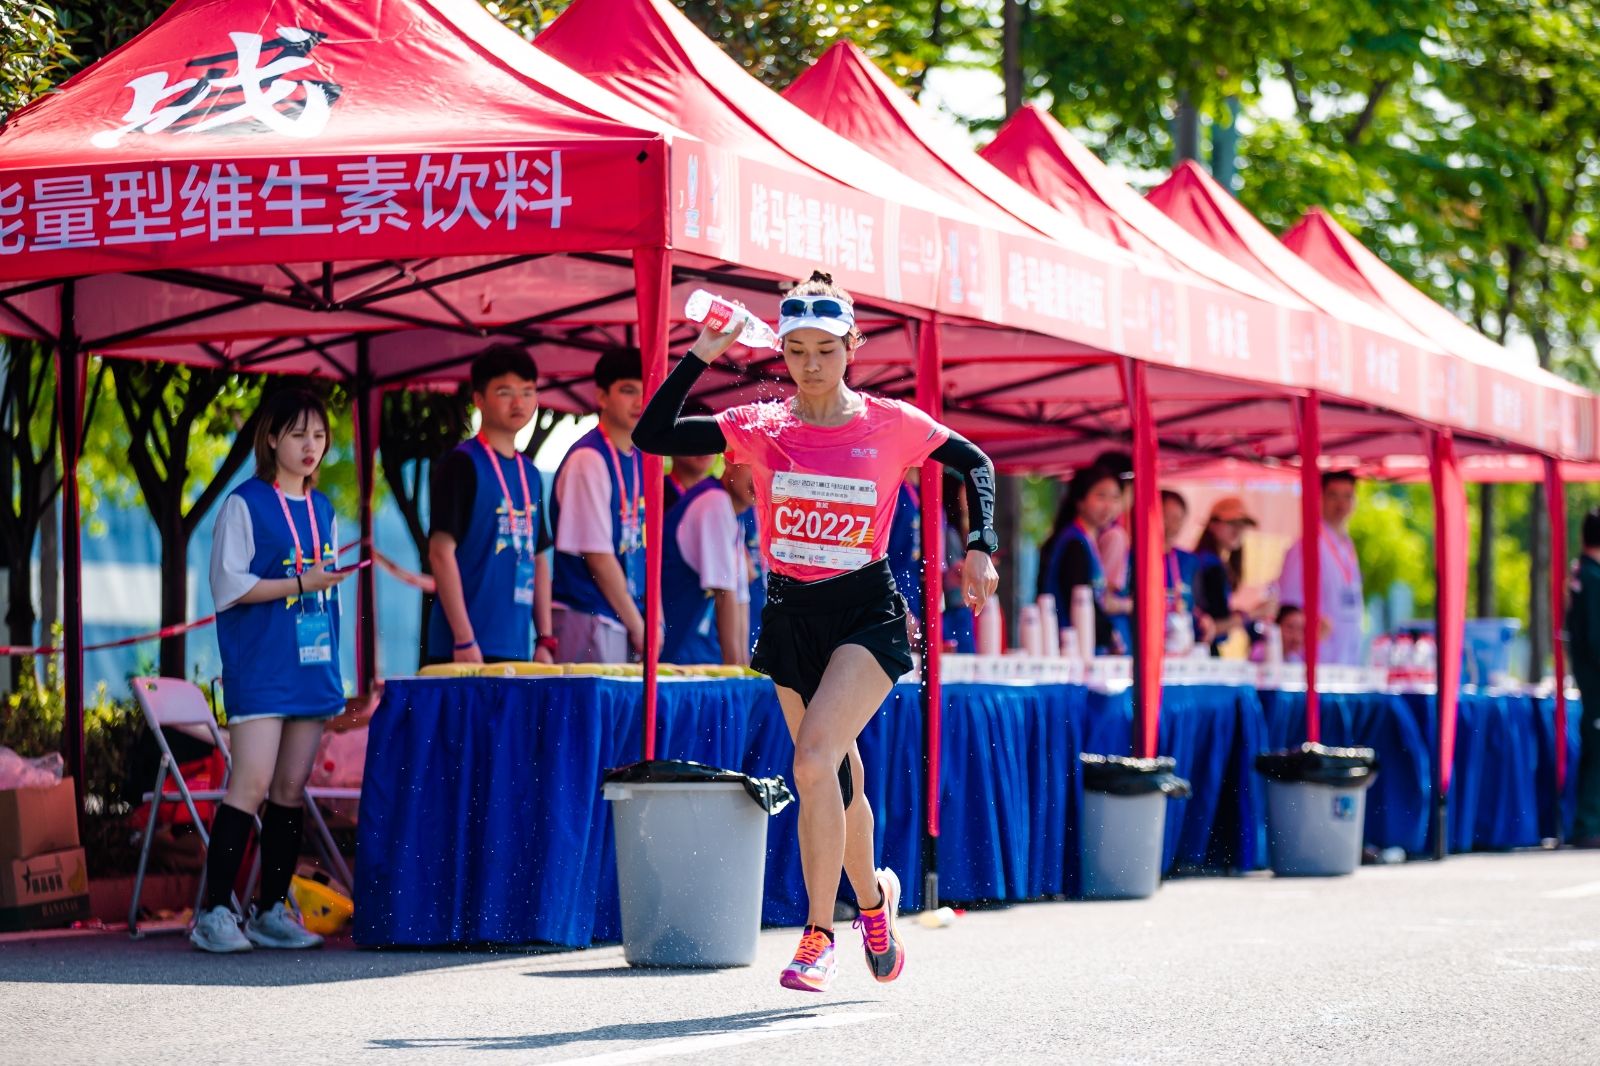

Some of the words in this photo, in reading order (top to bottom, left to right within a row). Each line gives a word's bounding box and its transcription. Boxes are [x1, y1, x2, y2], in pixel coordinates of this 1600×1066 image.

[750, 183, 876, 273] 战马能量补给区
[775, 505, 870, 543] C20227
